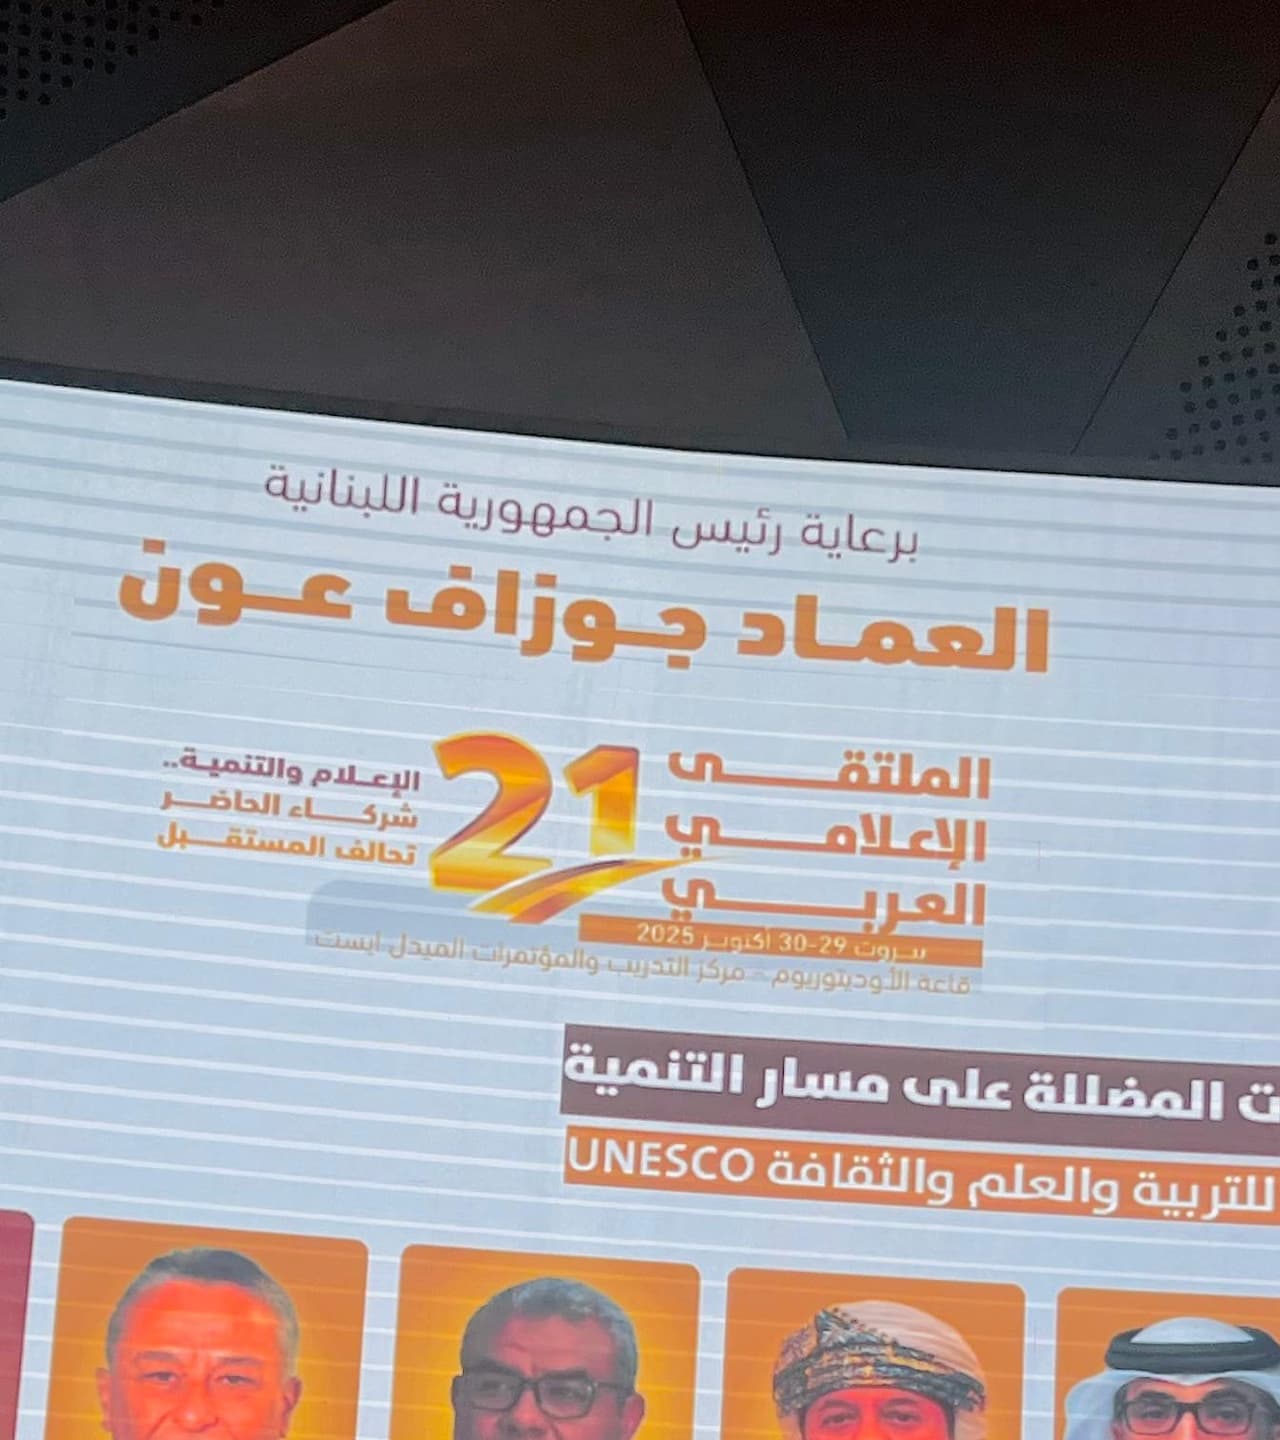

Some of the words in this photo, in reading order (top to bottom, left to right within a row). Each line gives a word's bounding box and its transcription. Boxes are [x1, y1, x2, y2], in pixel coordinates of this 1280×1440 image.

[265, 464, 420, 518] اللبنانية
[437, 482, 653, 541] الجمهورية
[672, 507, 783, 556] رئيس
[800, 513, 919, 563] برعاية
[118, 537, 352, 627] عون
[385, 564, 707, 671] جوزاف
[737, 593, 1049, 674] العماد
[311, 770, 420, 799] الإعلام
[668, 749, 991, 799] الملتقى
[160, 788, 281, 817] الحاضر
[288, 794, 418, 832] شركاء
[429, 731, 639, 892] 21
[156, 822, 325, 858] المستقبل
[336, 833, 417, 866] تحالف
[664, 813, 986, 870] الإعلامي
[661, 877, 986, 935] العربي
[388, 931, 465, 961] الميدل
[471, 942, 599, 975] والمؤتمرات
[636, 922, 694, 945] 2025
[607, 953, 689, 979] التدريب
[696, 956, 745, 985] مركز
[563, 1040, 744, 1097] التنمية
[754, 1055, 890, 1109] مسار
[902, 1068, 1013, 1111] على
[1023, 1069, 1225, 1121] المضللة
[567, 1136, 755, 1183] UNESCO
[766, 1150, 956, 1207] والثقافة
[968, 1162, 1120, 1215] والعلم
[1132, 1171, 1275, 1221] للتربية
